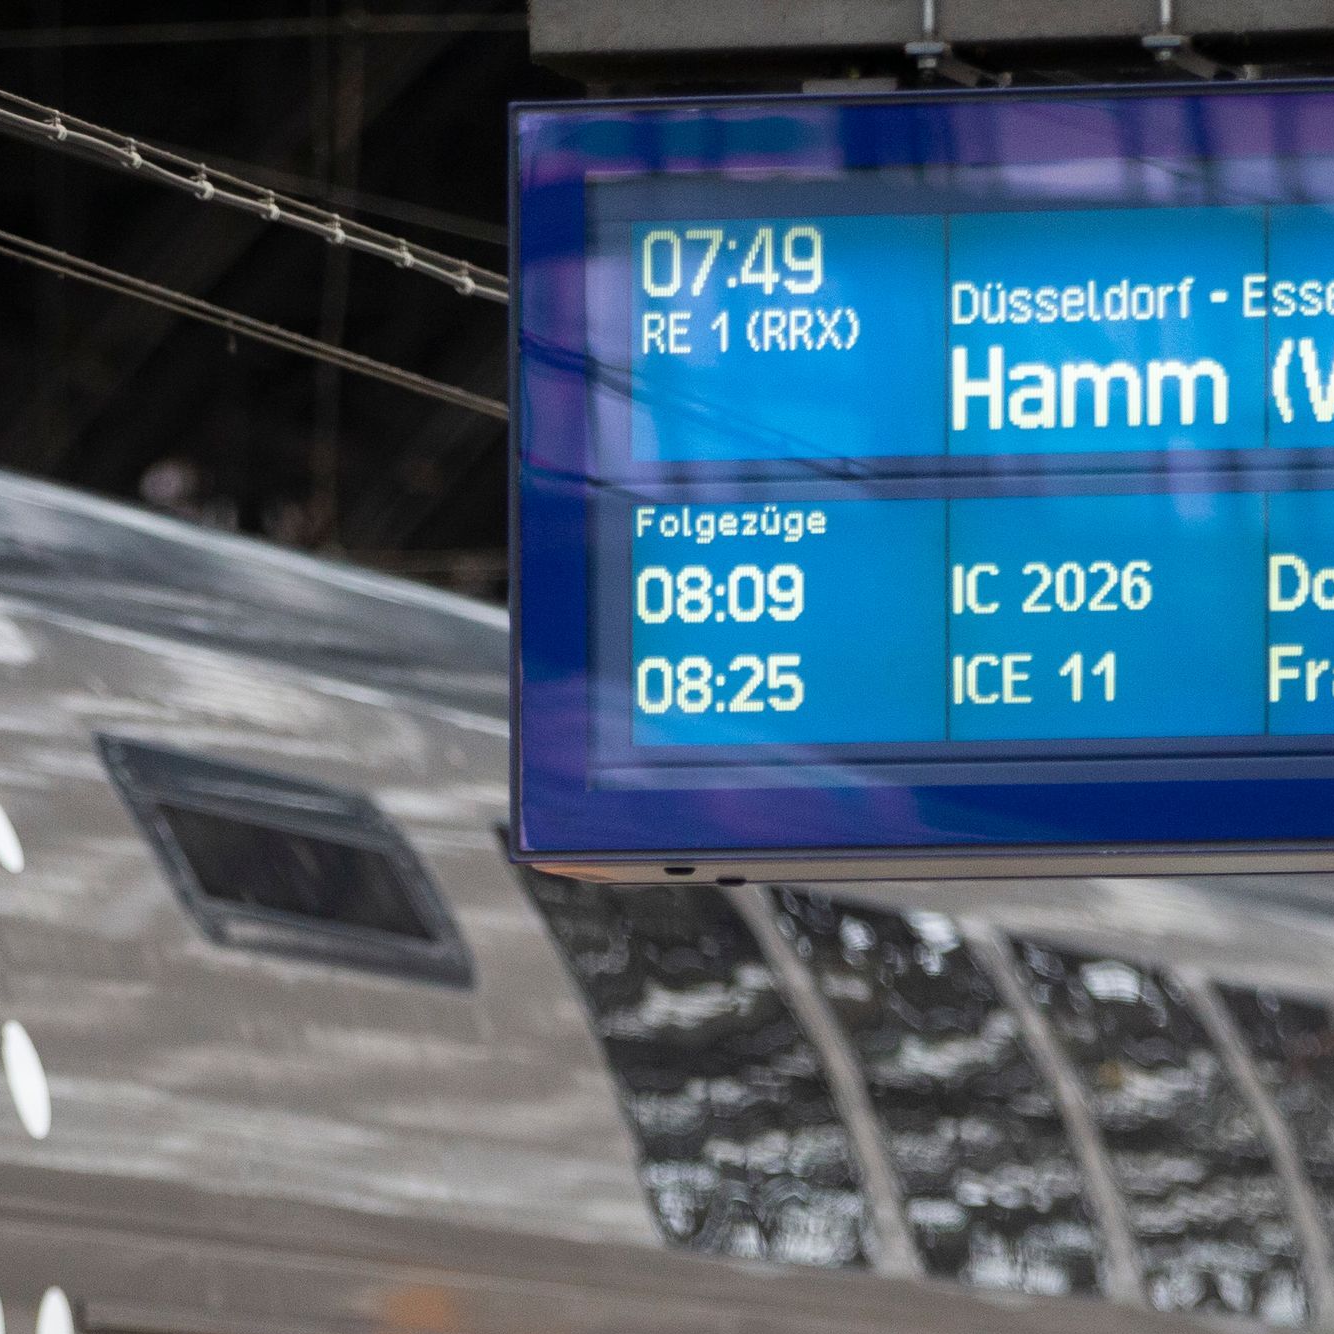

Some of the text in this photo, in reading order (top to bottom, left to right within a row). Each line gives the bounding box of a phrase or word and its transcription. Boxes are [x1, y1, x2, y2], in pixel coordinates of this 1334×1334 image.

[642, 226, 824, 298] 07:49
[951, 277, 1195, 326] Düsseldorf
[641, 307, 861, 355] RE 1 (RRX)
[951, 345, 1229, 431] Hamm
[636, 505, 827, 545] Folgezüge
[636, 563, 805, 625] 08:09
[951, 560, 1152, 615] IC 2026
[636, 653, 805, 715] 08:25
[951, 652, 1116, 705] ICE 11
